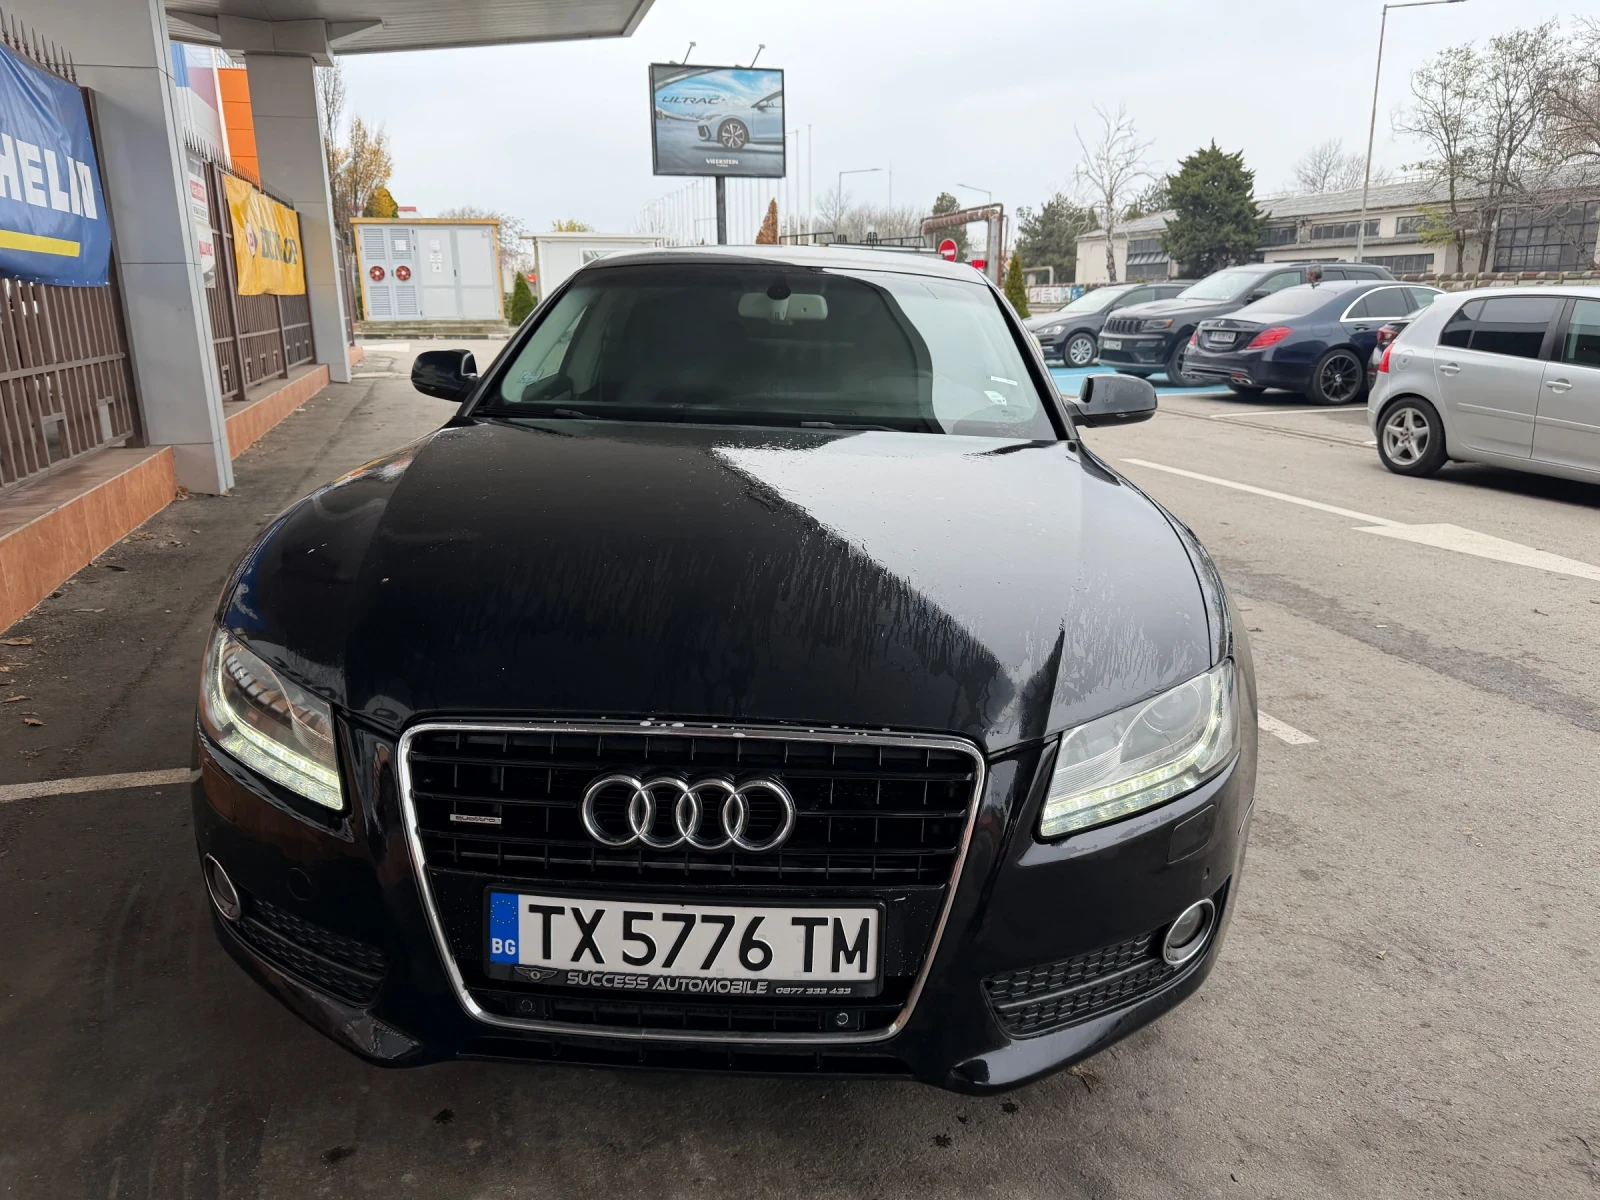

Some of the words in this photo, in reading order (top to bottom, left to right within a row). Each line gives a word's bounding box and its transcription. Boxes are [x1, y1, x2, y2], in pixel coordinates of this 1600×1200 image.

[455, 815, 496, 823] quattro
[491, 938, 516, 955] BG
[528, 904, 606, 964] TX
[622, 911, 773, 971] 5776
[791, 917, 870, 973] TM
[566, 972, 649, 989] SUCCESS
[652, 976, 768, 994] AUTOMOBILE
[805, 987, 827, 995] 333
[829, 987, 852, 995] 433
